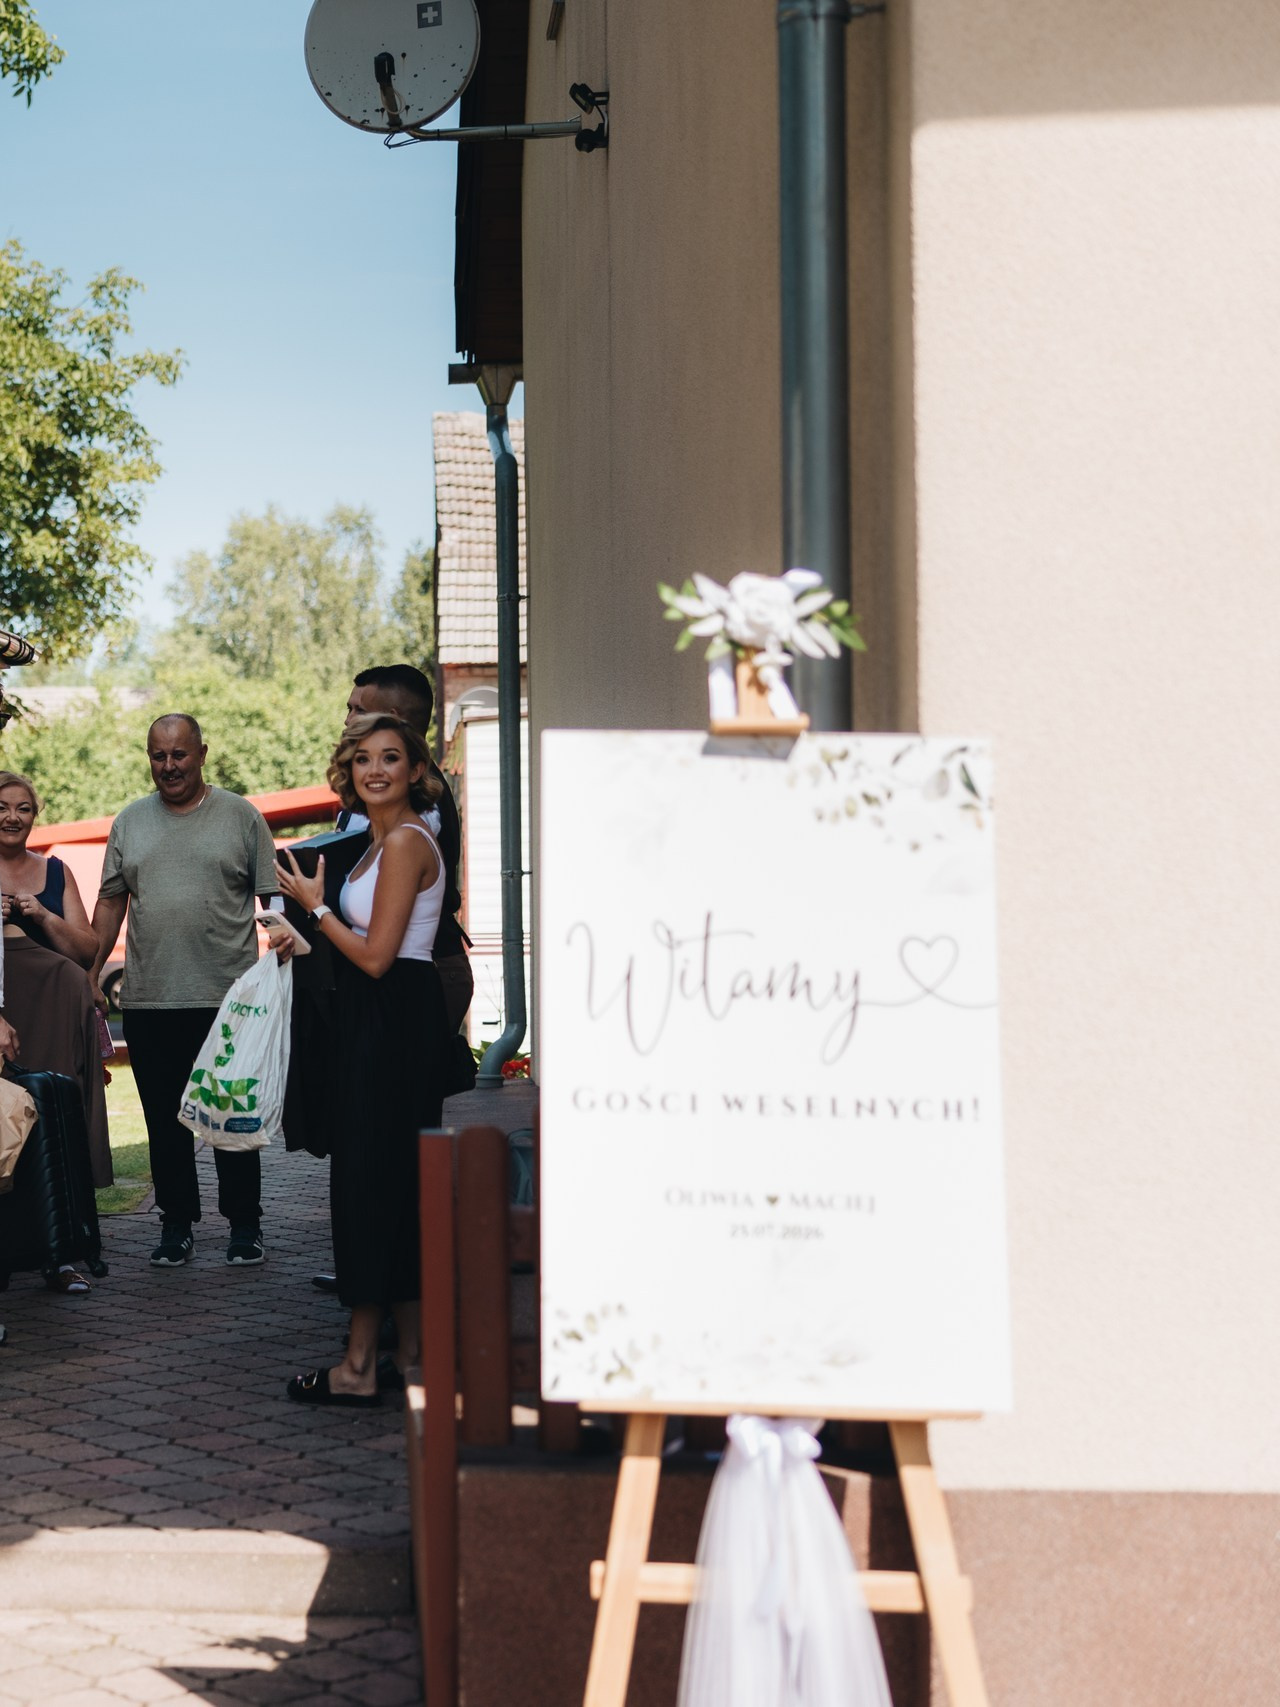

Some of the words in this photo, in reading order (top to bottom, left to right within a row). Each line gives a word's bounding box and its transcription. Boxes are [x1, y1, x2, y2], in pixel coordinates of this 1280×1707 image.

[565, 909, 861, 1066] Witamy
[571, 1085, 699, 1116] GOŚCI
[721, 1093, 980, 1123] WESELNYCH!
